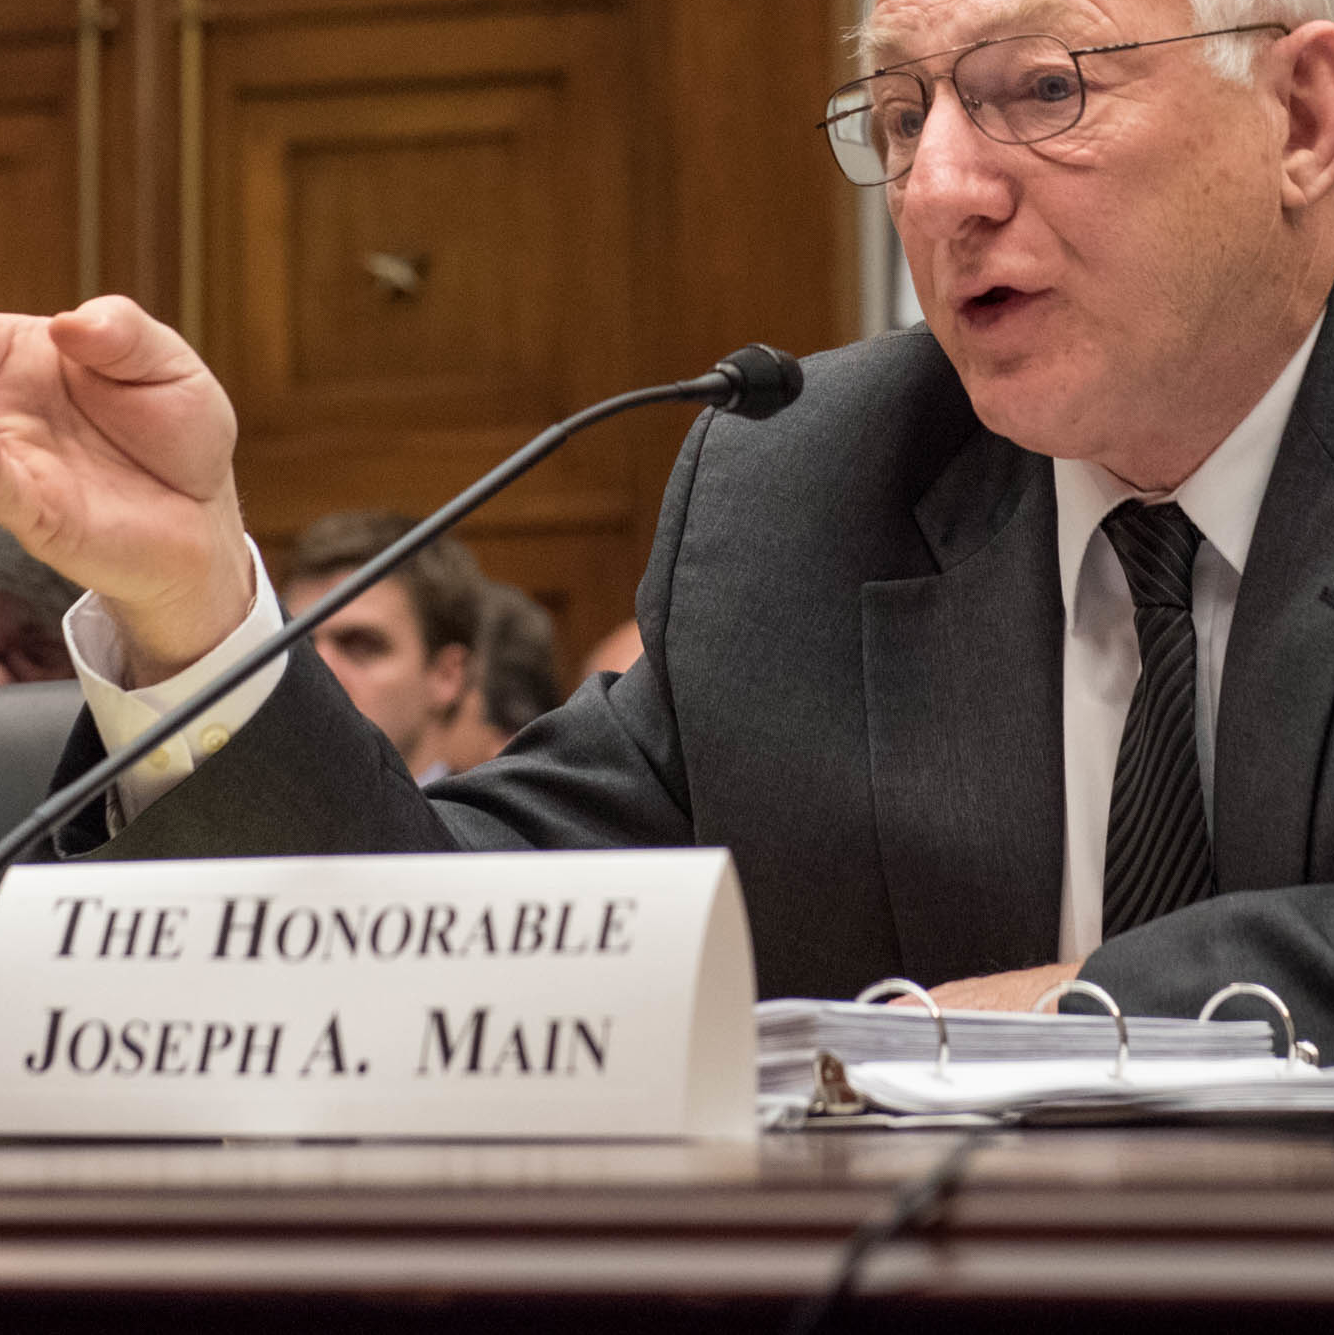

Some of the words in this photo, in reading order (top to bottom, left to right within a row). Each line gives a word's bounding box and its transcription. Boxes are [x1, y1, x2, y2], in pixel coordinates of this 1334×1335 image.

[23, 1006, 284, 1077] JOSEPH
[298, 1011, 370, 1077] A.
[415, 1004, 611, 1077] MAIN
